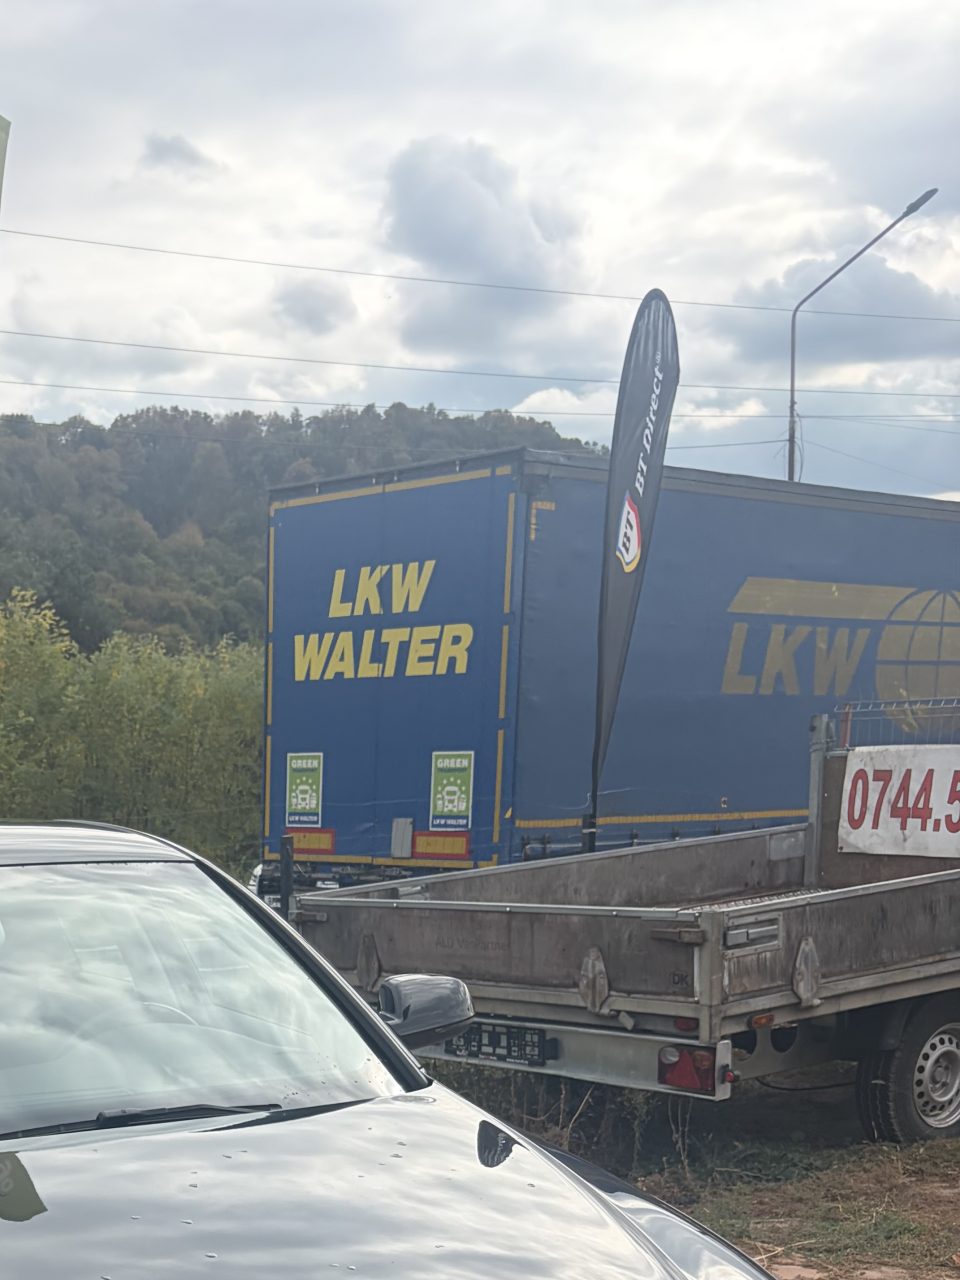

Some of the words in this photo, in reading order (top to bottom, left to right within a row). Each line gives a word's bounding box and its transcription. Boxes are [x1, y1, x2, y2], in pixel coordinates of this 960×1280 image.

[634, 452, 648, 497] BT
[643, 366, 664, 455] Direct
[622, 510, 635, 555] BT
[329, 560, 436, 618] LKW
[294, 623, 474, 682] WALTER
[721, 622, 871, 696] LKW
[291, 759, 319, 769] GREEN
[437, 758, 469, 768] GREEN
[847, 768, 960, 834] 0744.5
